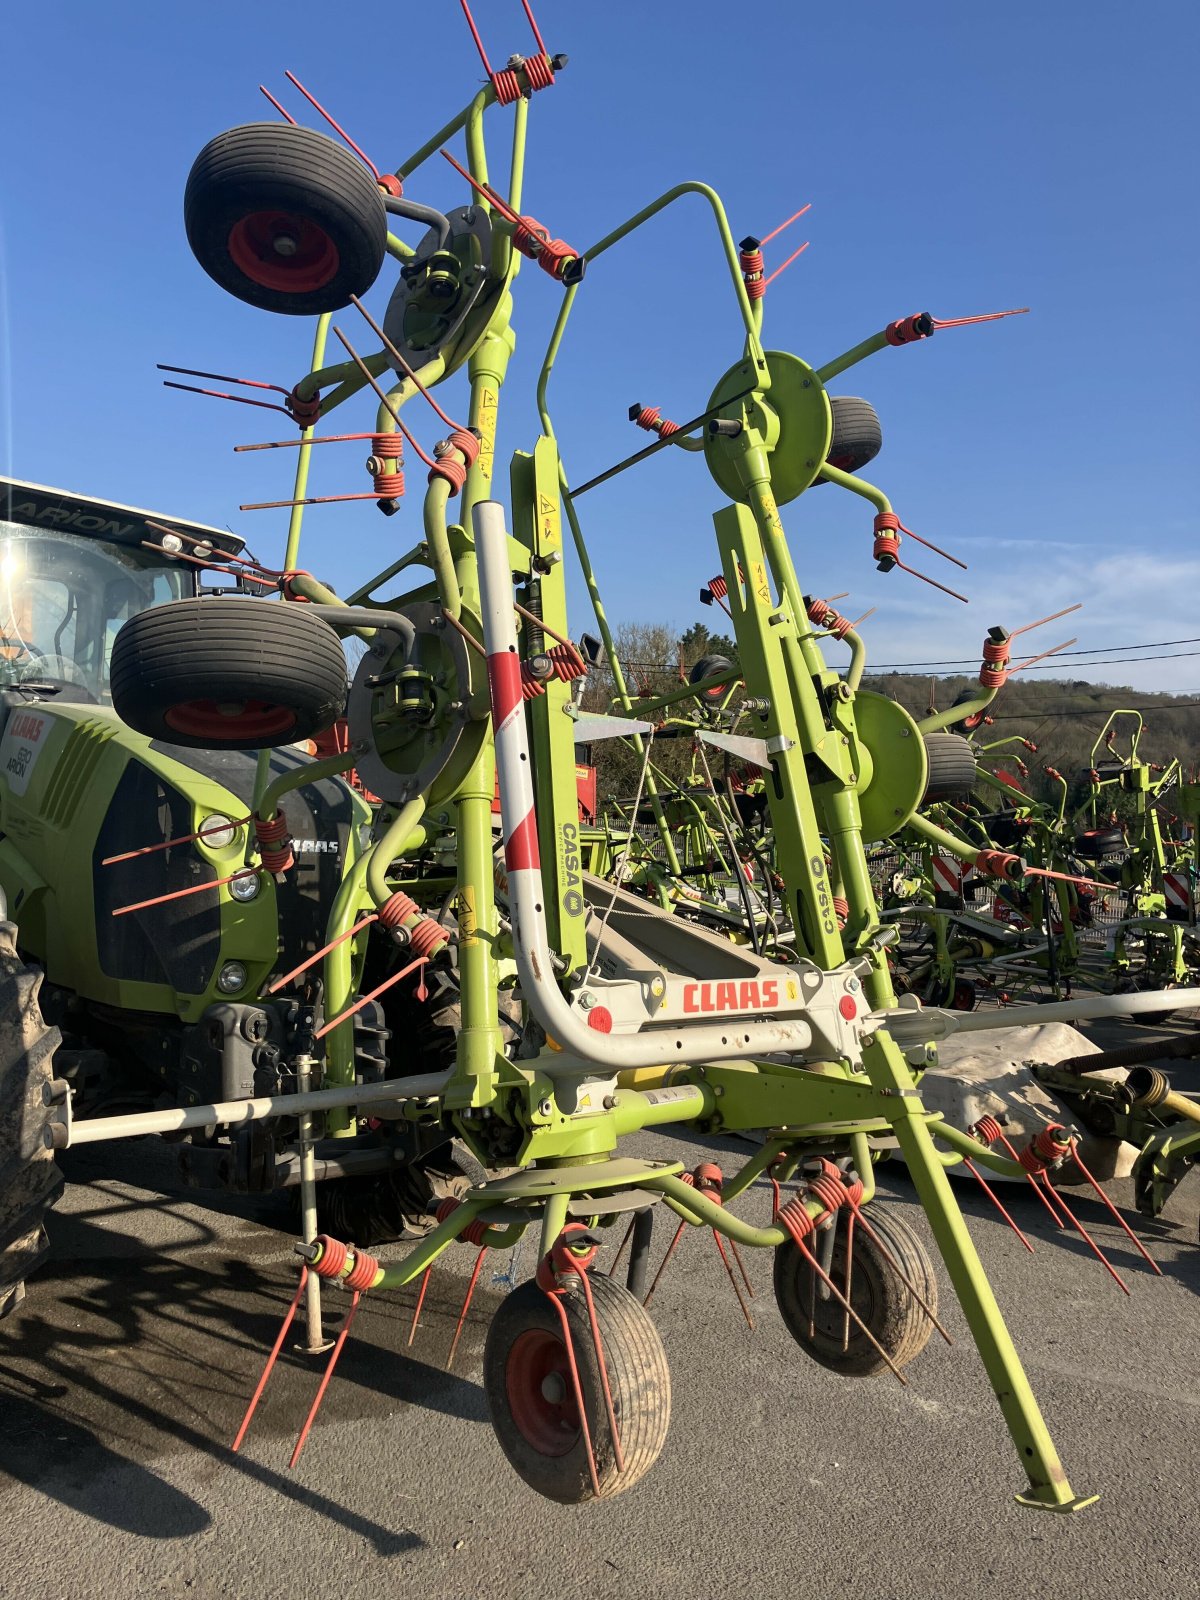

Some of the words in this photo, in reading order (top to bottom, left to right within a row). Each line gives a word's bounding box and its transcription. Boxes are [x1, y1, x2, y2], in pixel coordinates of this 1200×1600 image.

[13, 502, 135, 536] ARION
[288, 839, 338, 853] LAAS
[562, 823, 579, 887] CASA
[815, 879, 834, 935] CASA
[683, 980, 779, 1013] CLAAS
